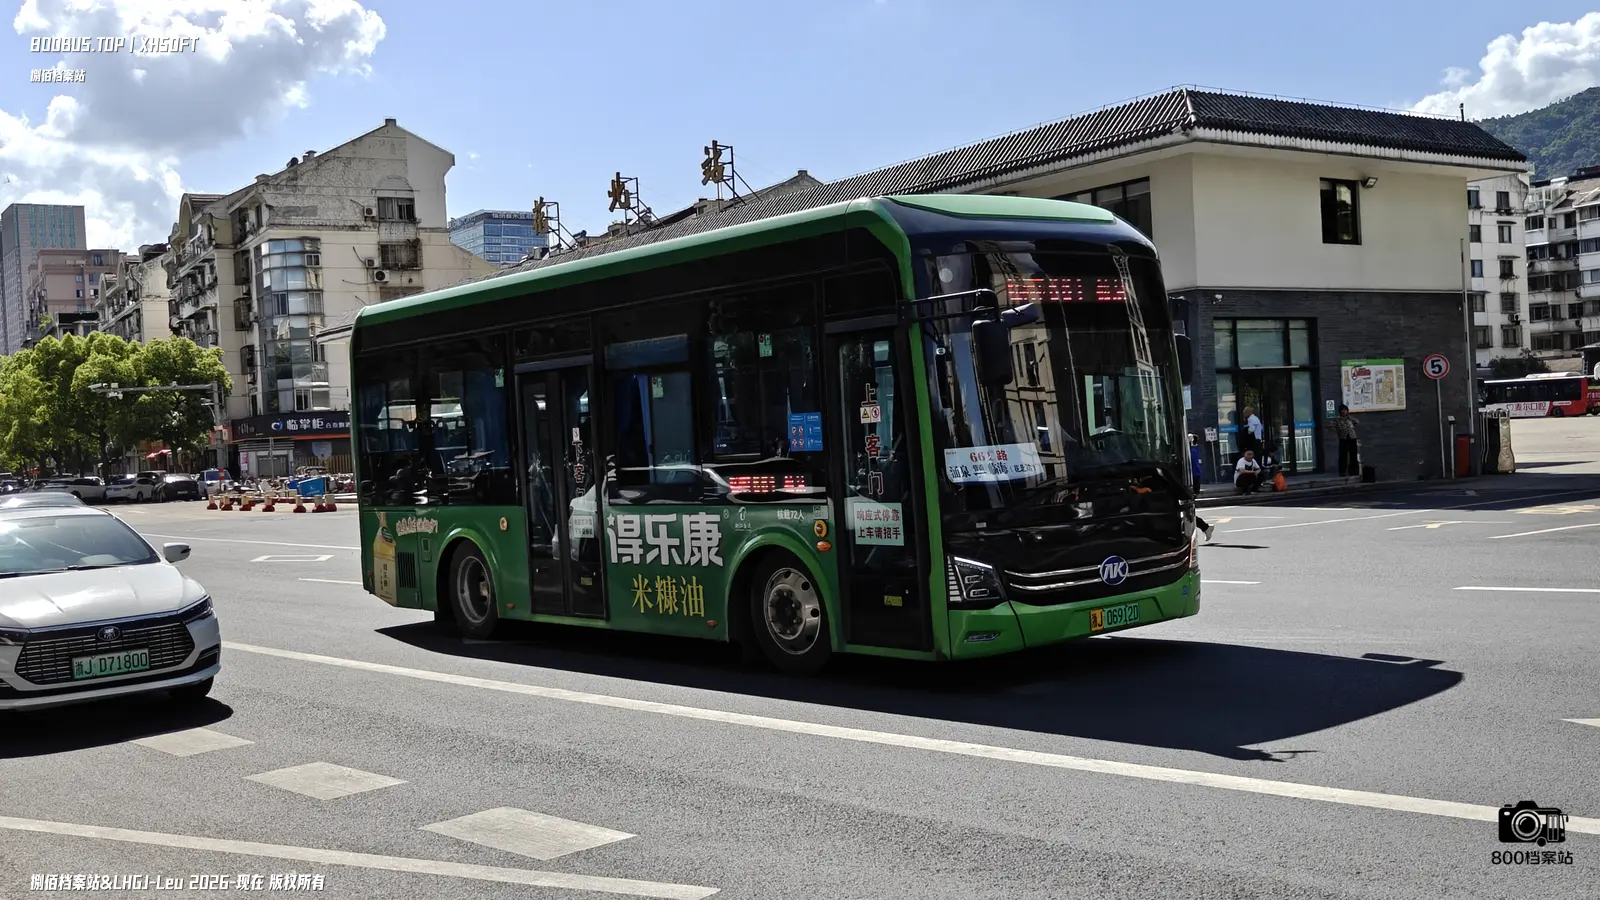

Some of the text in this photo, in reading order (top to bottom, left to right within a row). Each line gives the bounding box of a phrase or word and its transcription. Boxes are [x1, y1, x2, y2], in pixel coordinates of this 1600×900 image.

[1430, 359, 1443, 375] 5
[861, 383, 884, 495] 上客门
[856, 508, 900, 522] 响应式停靠
[606, 511, 724, 567] 得乐康
[857, 526, 901, 540] 上车请招手
[631, 573, 705, 617] 米糠油
